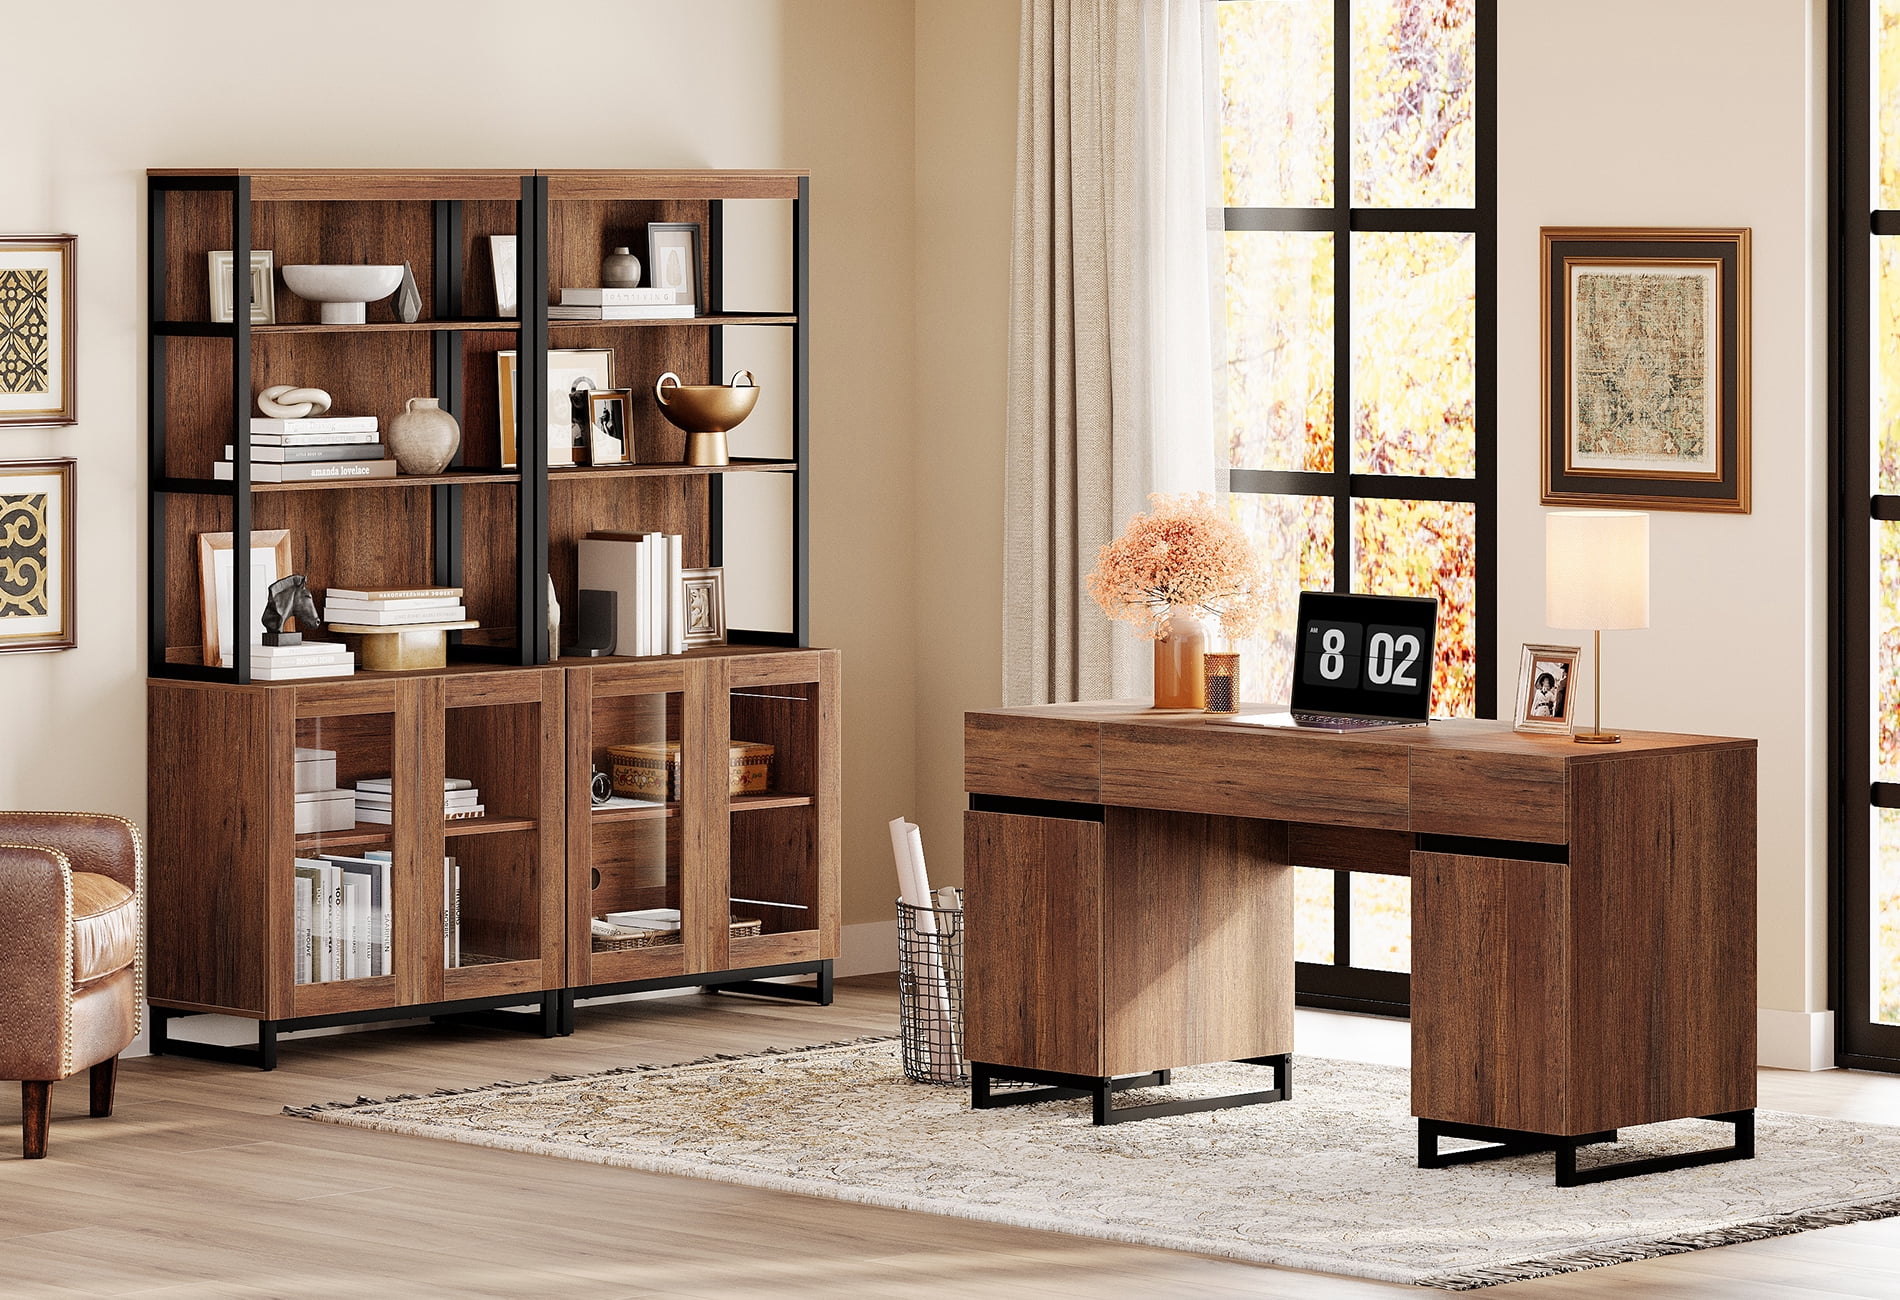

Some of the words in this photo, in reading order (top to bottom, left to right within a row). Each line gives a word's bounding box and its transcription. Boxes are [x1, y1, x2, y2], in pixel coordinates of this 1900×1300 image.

[311, 466, 339, 477] amanda
[341, 465, 370, 476] lovelace
[1319, 628, 1346, 681] 8
[1368, 632, 1421, 687] 02
